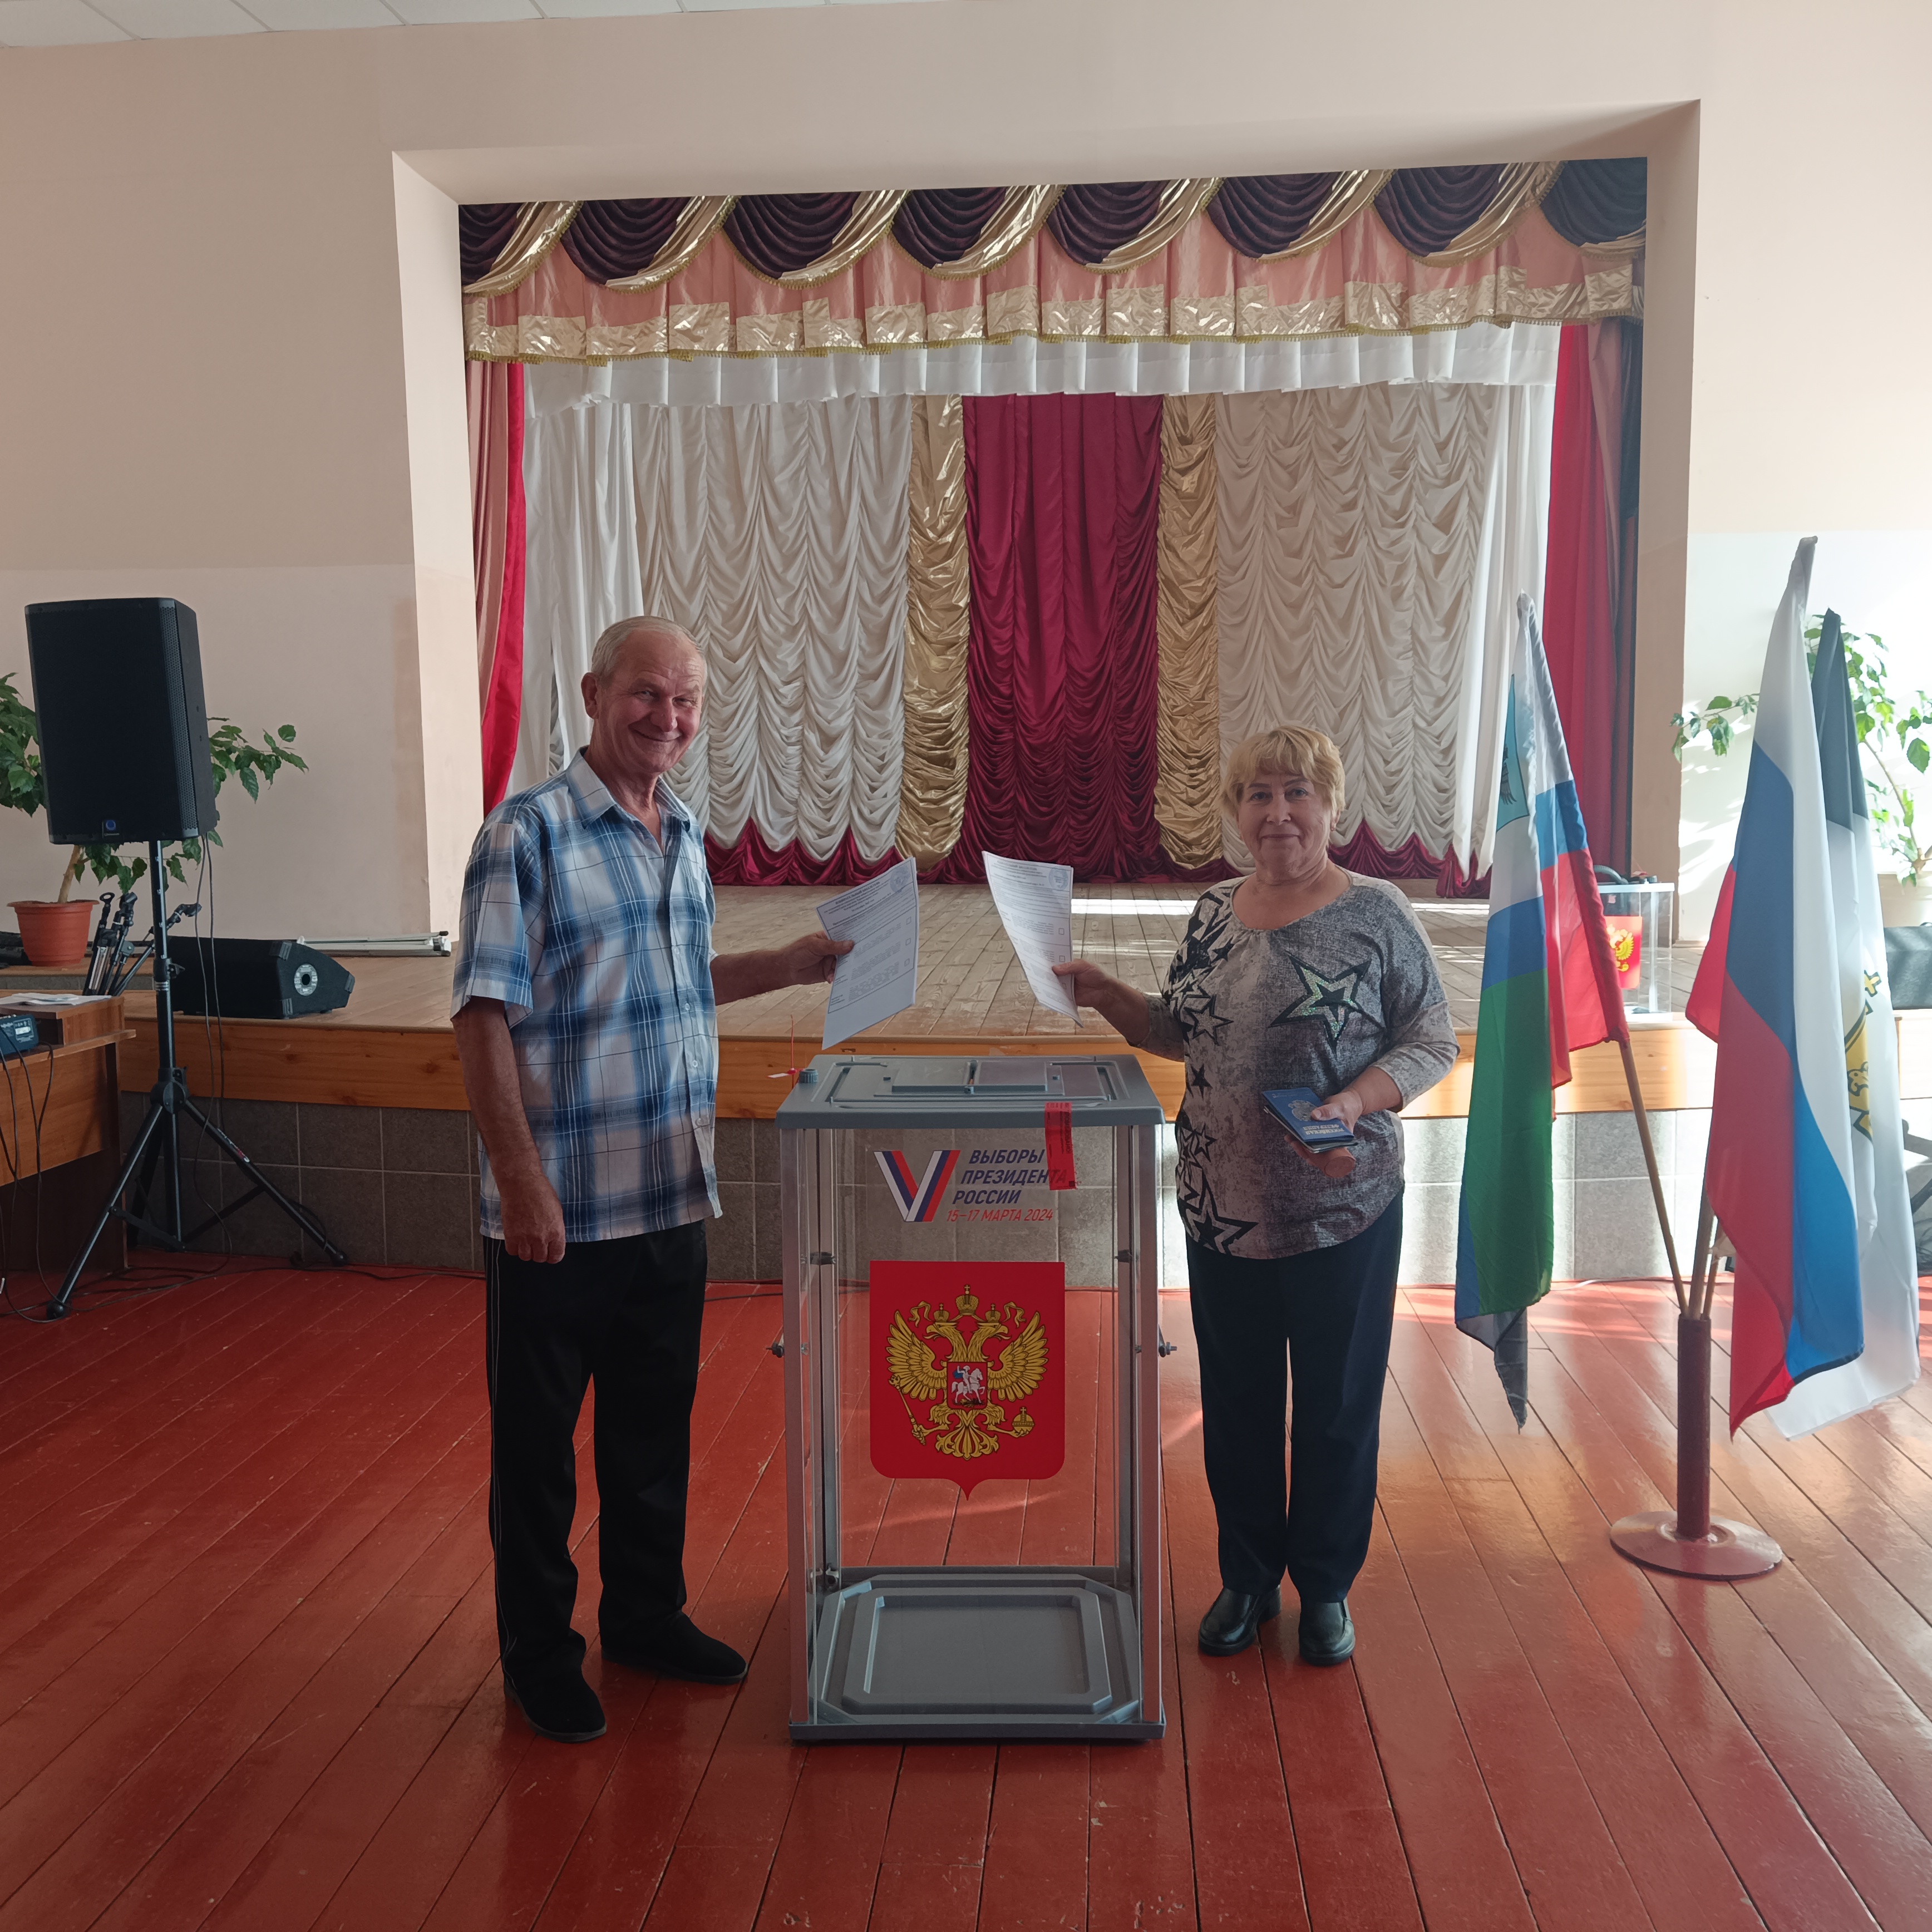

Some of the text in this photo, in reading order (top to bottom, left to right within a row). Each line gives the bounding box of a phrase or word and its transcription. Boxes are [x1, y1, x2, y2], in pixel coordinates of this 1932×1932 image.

[969, 1149, 1046, 1164] ВЫБОРЫ
[952, 1190, 1022, 1205] РОССИИ
[980, 1209, 1022, 1221] МАРТА
[1024, 1209, 1053, 1221] 2024
